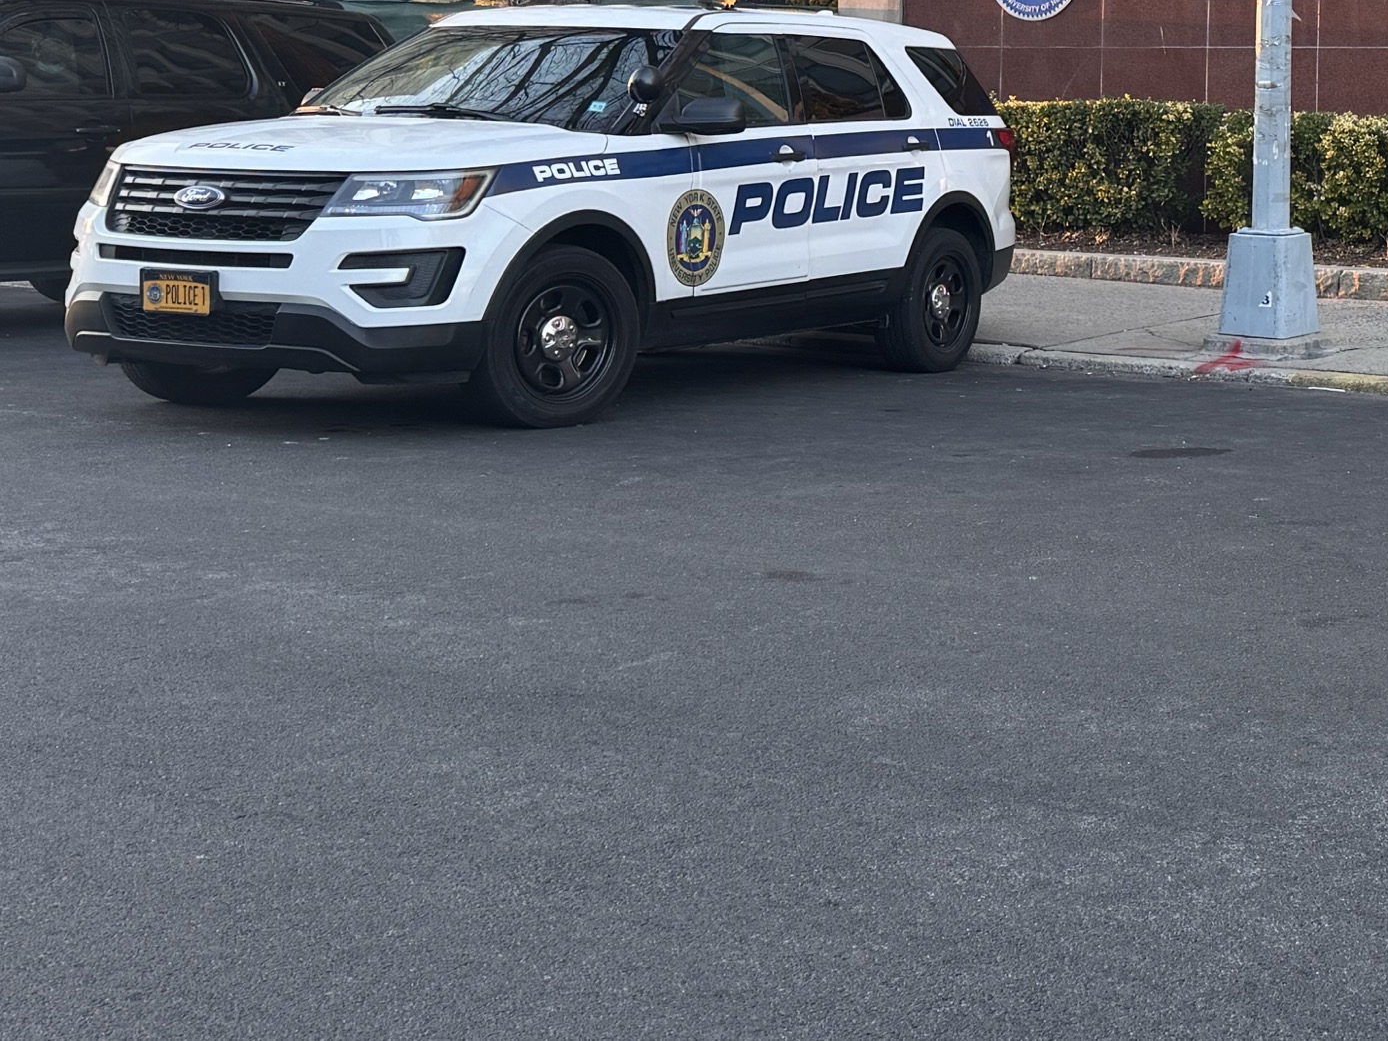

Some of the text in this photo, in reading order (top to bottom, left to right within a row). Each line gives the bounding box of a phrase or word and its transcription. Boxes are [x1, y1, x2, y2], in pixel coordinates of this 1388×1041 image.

[1040, 3, 1051, 12] OF
[948, 117, 967, 127] DIAL
[188, 142, 295, 153] POLICE
[986, 130, 995, 147] 1
[532, 158, 621, 183] POLICE
[181, 188, 212, 202] Ford
[728, 166, 925, 236] POLICE
[670, 192, 722, 227] NEW YORK STATE
[669, 243, 721, 283] UNIVERSITY POLICE
[165, 284, 199, 306] POLICE
